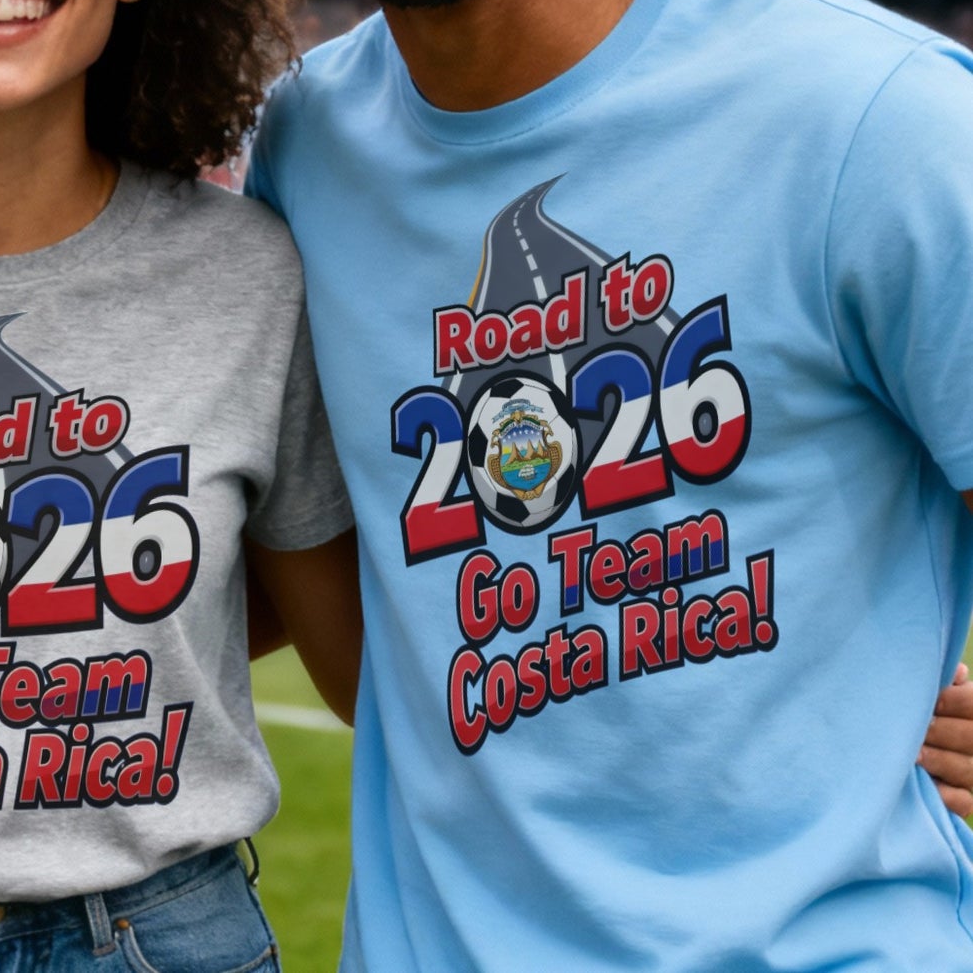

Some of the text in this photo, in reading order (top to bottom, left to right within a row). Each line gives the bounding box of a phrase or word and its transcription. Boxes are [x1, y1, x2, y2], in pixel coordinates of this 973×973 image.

[433, 251, 674, 376] Road to
[48, 388, 130, 460] to
[391, 294, 751, 566] 2026
[456, 509, 728, 648] Go Team
[447, 548, 778, 756] Costa Rica!
[14, 701, 193, 809] Rica!
